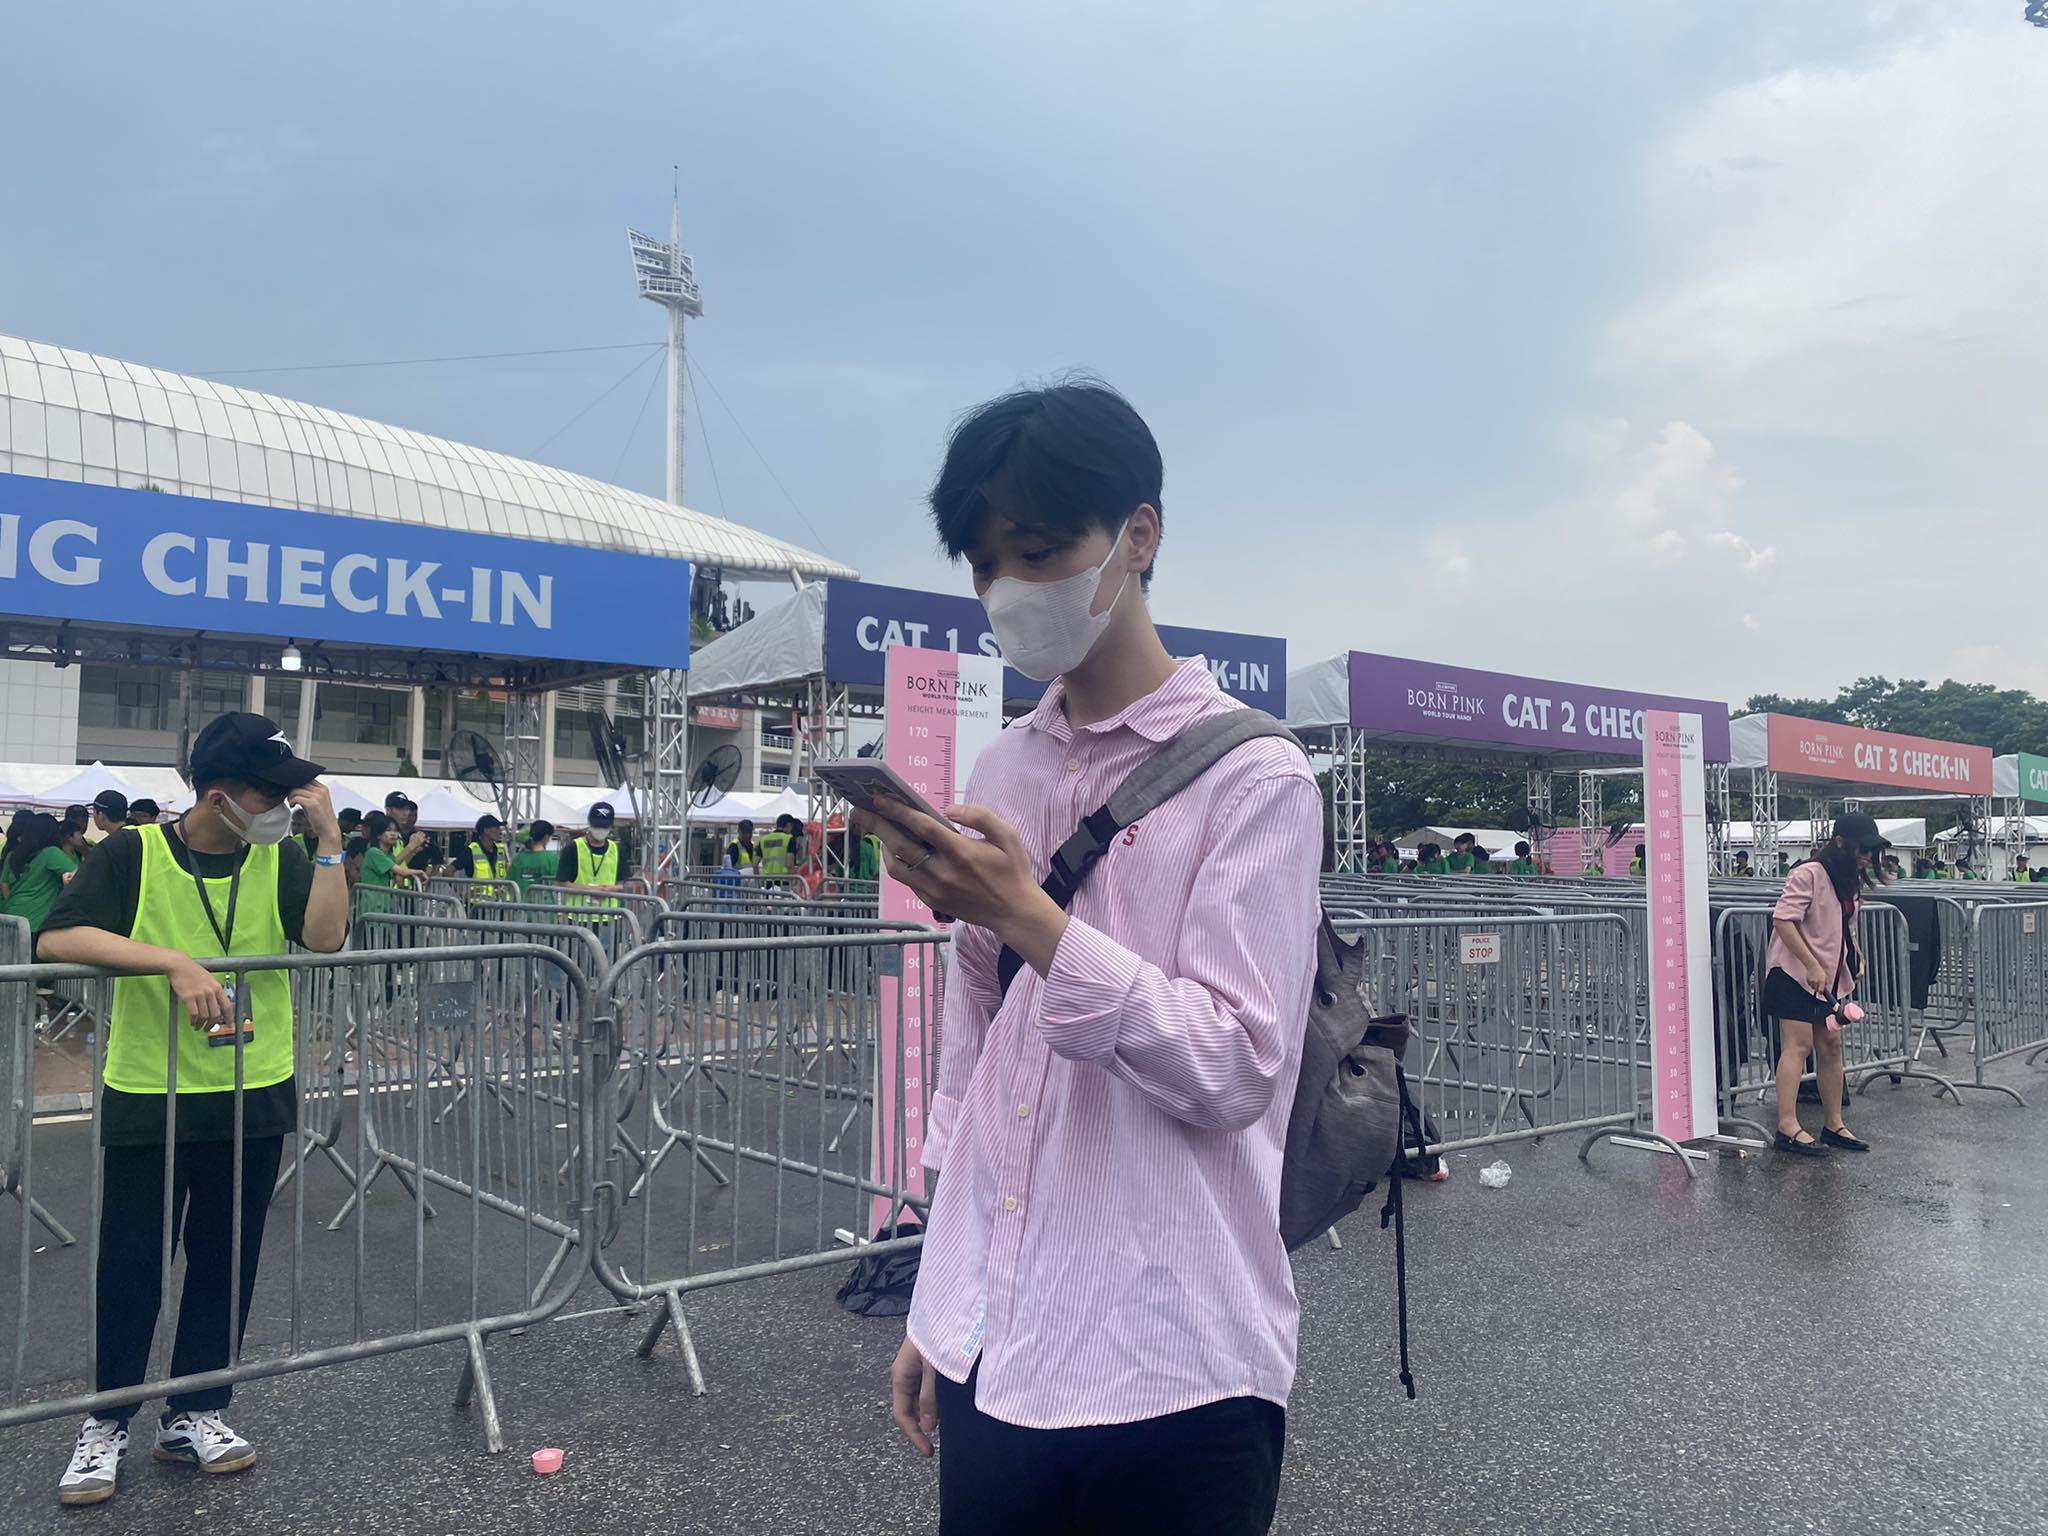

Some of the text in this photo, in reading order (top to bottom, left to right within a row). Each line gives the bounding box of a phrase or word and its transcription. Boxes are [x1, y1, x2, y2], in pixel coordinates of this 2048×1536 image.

[142, 531, 553, 629] CHECK-IN
[856, 616, 928, 653] CAT
[946, 628, 958, 653] 1
[907, 676, 988, 697] BORN PINK
[1408, 689, 1485, 715] BORN PINK
[907, 705, 989, 719] HEIGHT MEASUREMENT
[1502, 693, 1551, 730] CAT
[1561, 701, 1576, 733] 2
[909, 726, 929, 738] 170
[908, 756, 928, 767] 160
[1854, 743, 1970, 782] CAT 3 CHECK-IN
[2030, 768, 2048, 791] CAT
[1122, 824, 1139, 847] S
[905, 899, 925, 910] 110
[1469, 947, 1493, 959] STOP
[907, 986, 920, 998] 80
[907, 1017, 920, 1029] 70
[905, 1046, 920, 1058] 60
[905, 1077, 919, 1089] 50
